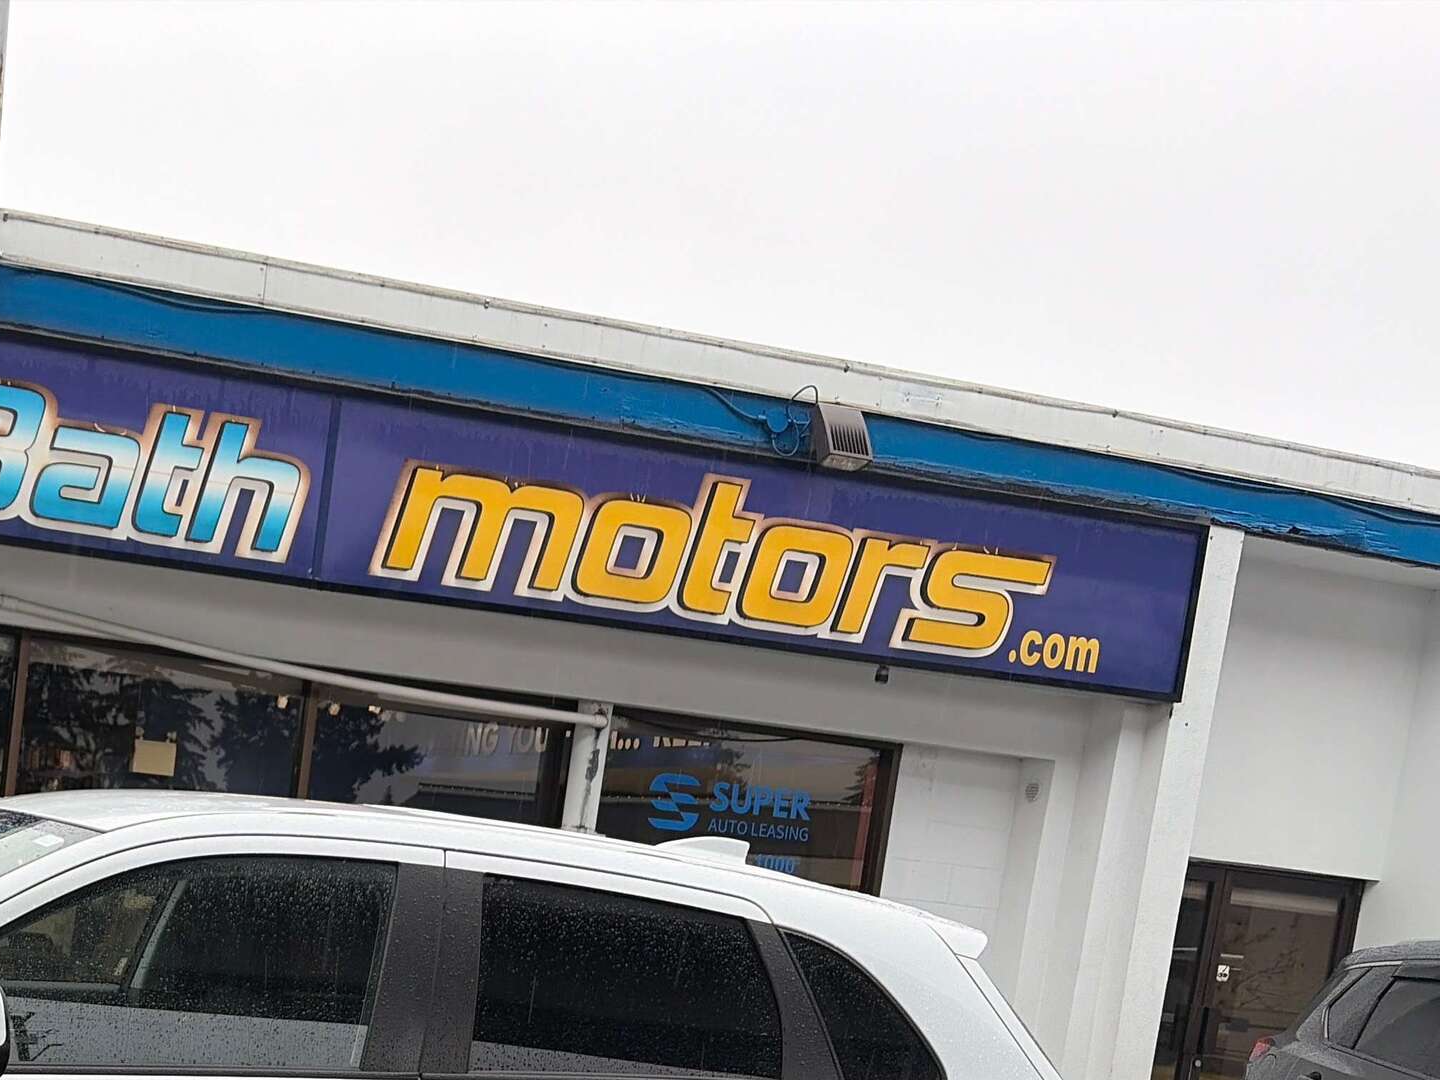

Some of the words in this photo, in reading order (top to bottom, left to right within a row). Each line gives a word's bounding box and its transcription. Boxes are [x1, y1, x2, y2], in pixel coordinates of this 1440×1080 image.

[368, 458, 1056, 659] motors
[1008, 630, 1100, 674] .com
[709, 781, 811, 821] SUPER
[707, 818, 748, 835] AUTO
[751, 822, 809, 841] LEASING
